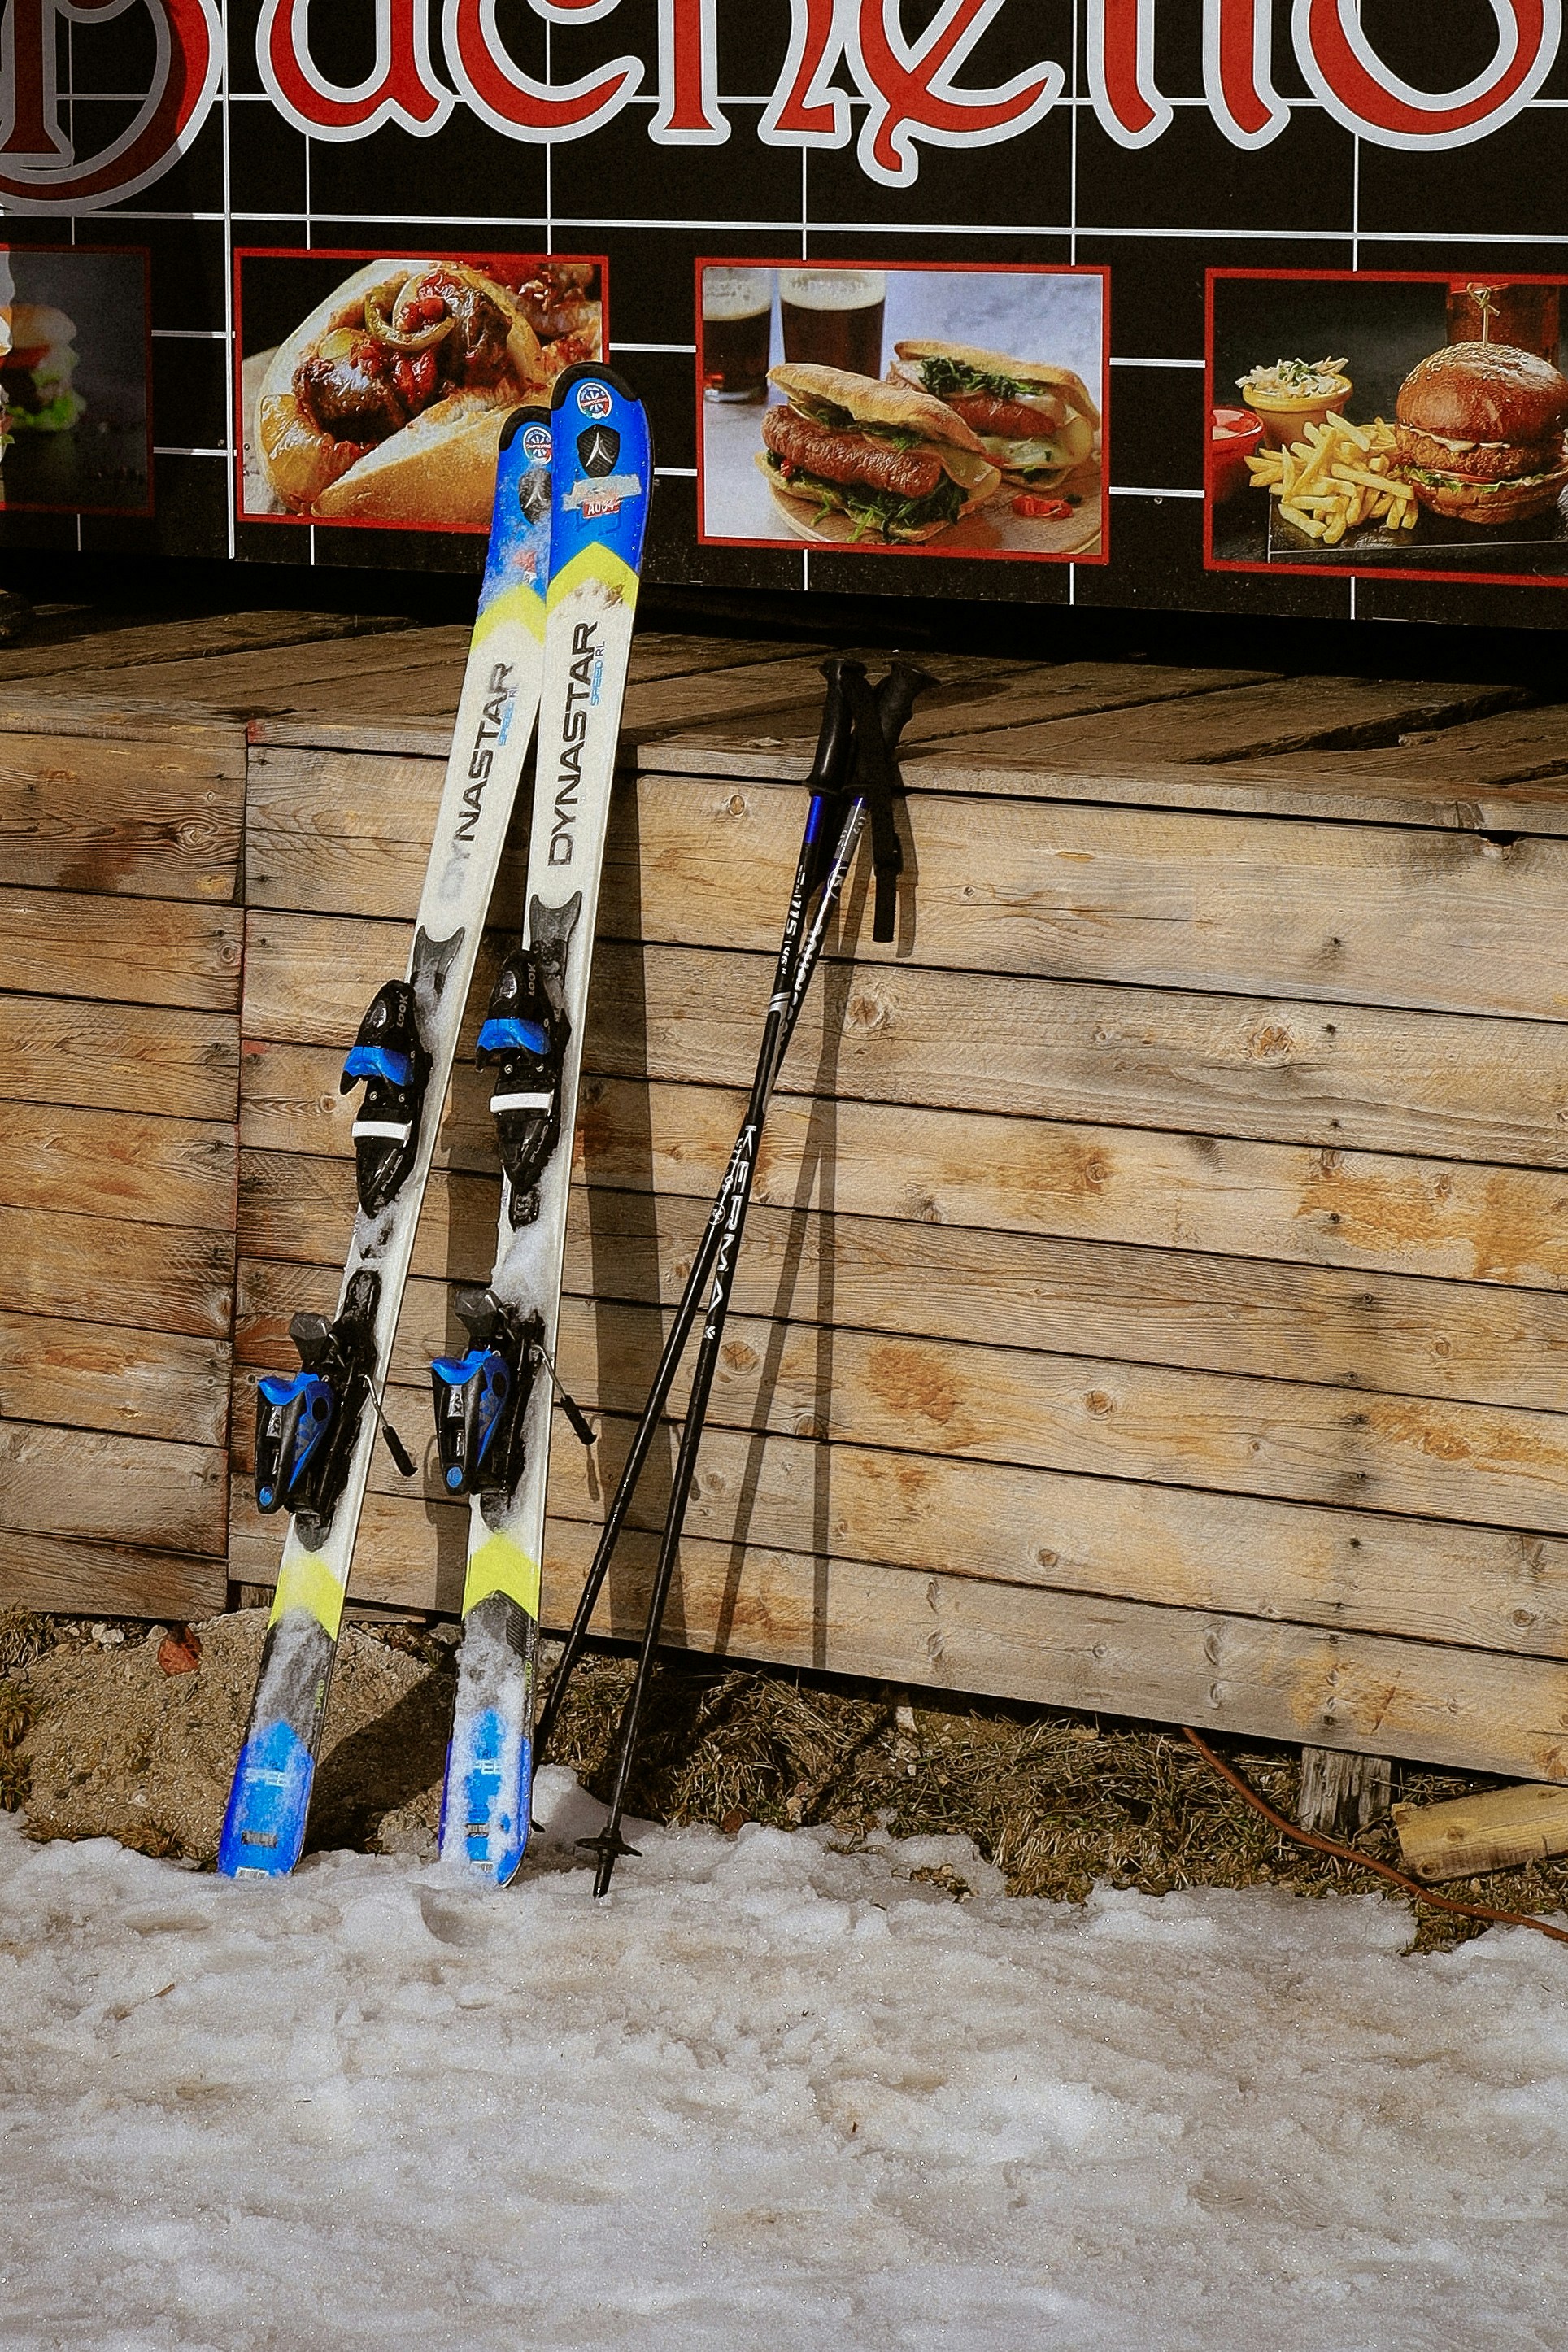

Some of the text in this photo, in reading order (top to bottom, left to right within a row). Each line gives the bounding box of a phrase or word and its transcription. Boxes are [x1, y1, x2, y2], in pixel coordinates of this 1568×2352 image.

[591, 641, 604, 706] SPEED RL
[440, 662, 513, 900] YNASTAR
[547, 621, 598, 866] DYNASTAR
[396, 994, 409, 1027] LOOK
[528, 962, 536, 997] LOOK
[708, 1126, 756, 1315] KERMA
